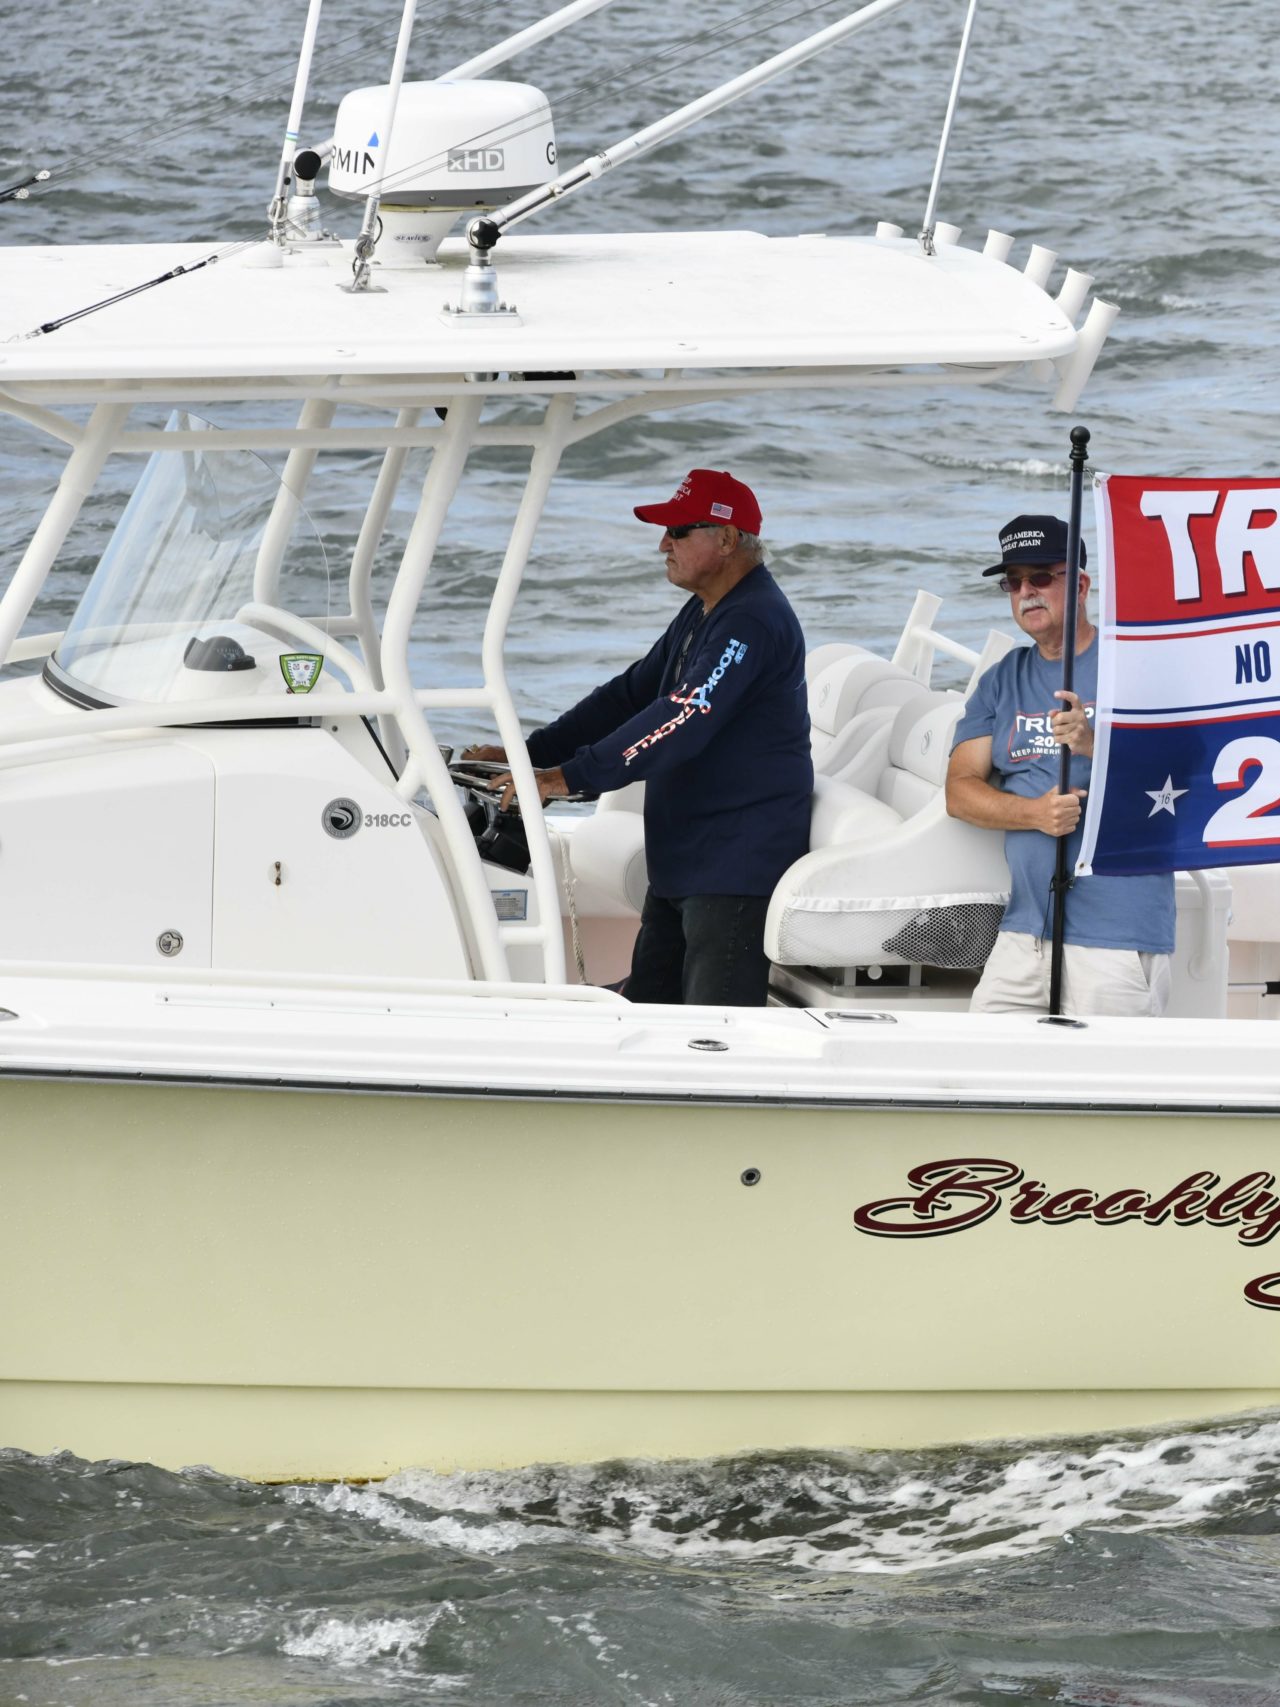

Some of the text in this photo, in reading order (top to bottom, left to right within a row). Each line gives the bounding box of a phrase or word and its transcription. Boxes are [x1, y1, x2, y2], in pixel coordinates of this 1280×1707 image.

[449, 150, 503, 170] xHD
[1014, 530, 1045, 540] AMERICA
[1002, 539, 1041, 552] GREAT AGAIN
[703, 638, 740, 693] HOOK
[1235, 640, 1271, 684] NO
[1016, 707, 1094, 733] TRUP
[622, 705, 696, 761] TACKLE
[1011, 749, 1031, 758] KEEP
[364, 813, 411, 828] 318CC
